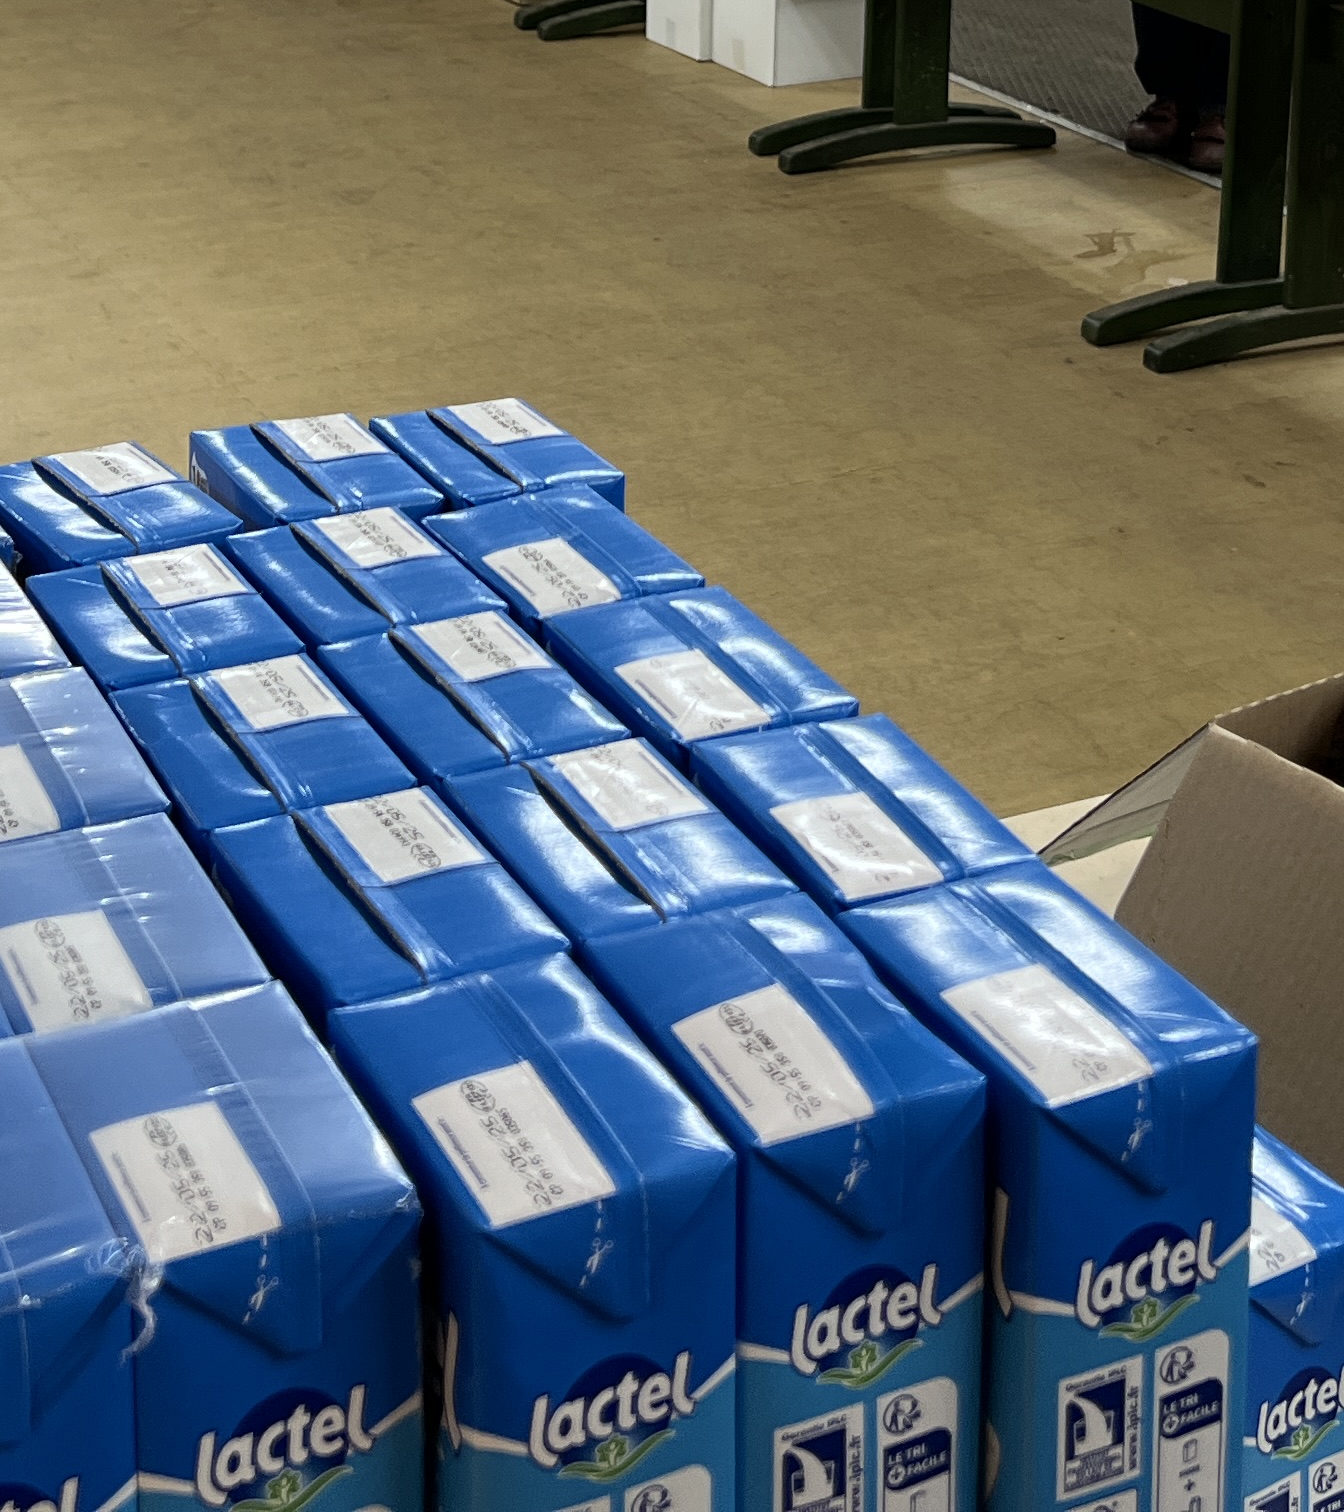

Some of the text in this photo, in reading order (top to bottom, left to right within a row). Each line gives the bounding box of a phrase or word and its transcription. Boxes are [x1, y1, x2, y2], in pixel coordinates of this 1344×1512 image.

[46, 947, 92, 1021] 22/05/25
[738, 1035, 813, 1122] 22/05/25
[153, 1147, 215, 1246] 22/05/25
[478, 1112, 552, 1206] 22/05/25
[1074, 1219, 1219, 1329] lactel
[790, 1263, 944, 1376] lactel
[196, 1384, 376, 1506] lactel
[529, 1349, 696, 1469] lactel
[1163, 1392, 1199, 1414] LE TRI
[1180, 1400, 1219, 1423] FACILE
[888, 1441, 926, 1465] LE TRI
[907, 1450, 948, 1476] FACILE
